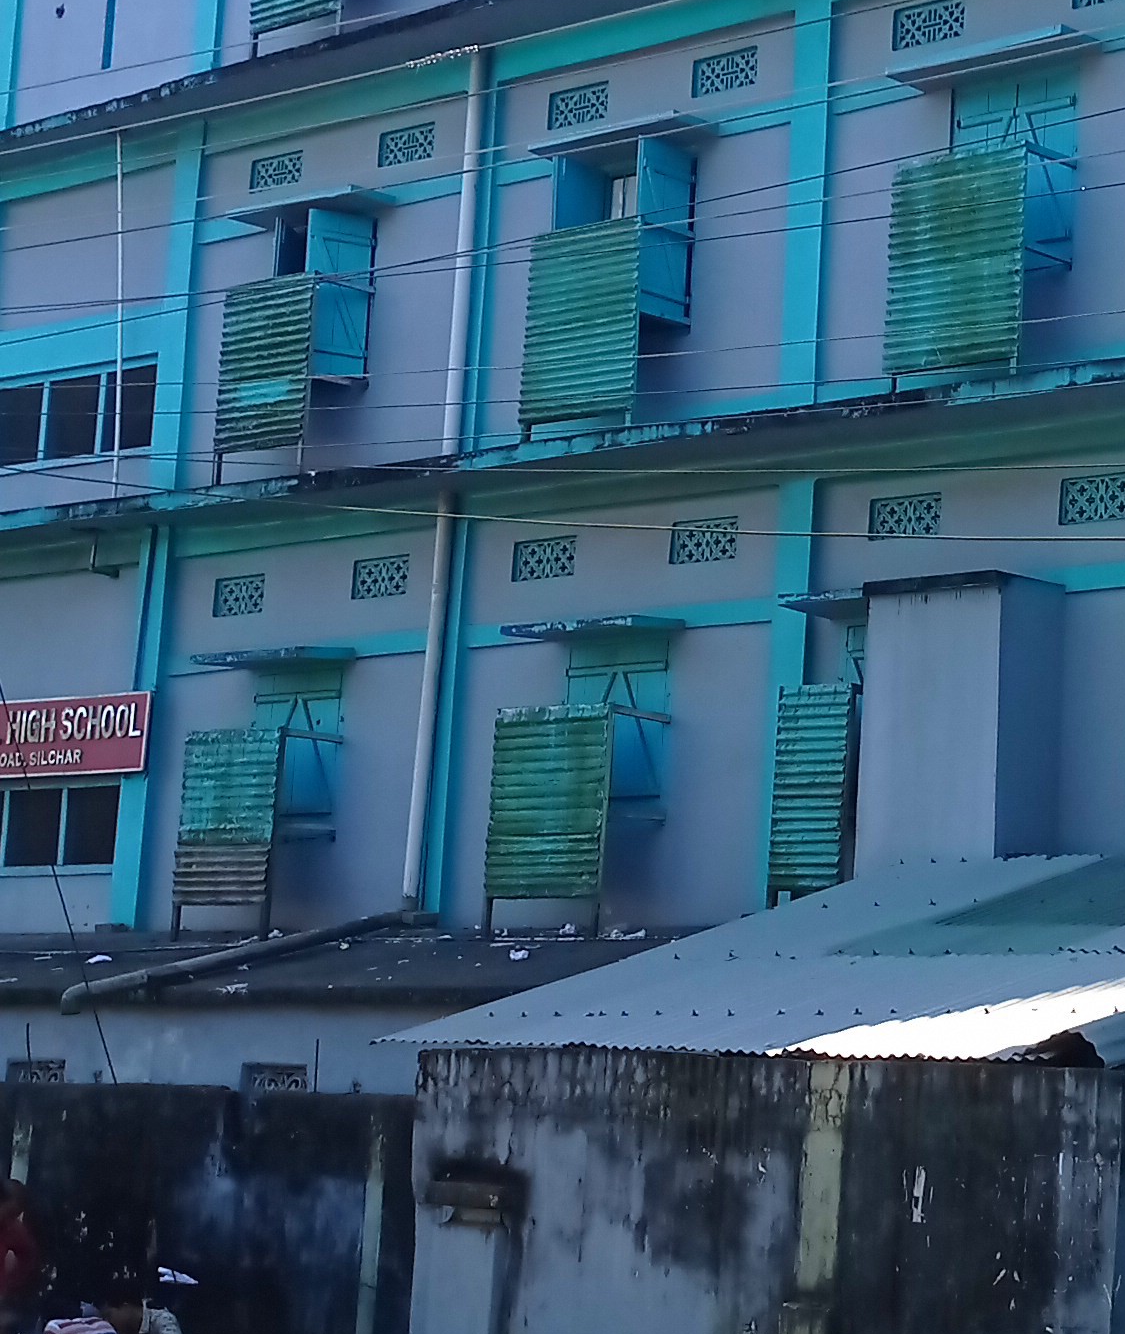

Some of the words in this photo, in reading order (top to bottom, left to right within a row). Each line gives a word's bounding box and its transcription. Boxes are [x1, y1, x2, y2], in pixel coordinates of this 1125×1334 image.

[6, 708, 56, 745] HIGH
[60, 703, 141, 740] SCHOOL
[29, 749, 82, 766] SILCHAR
